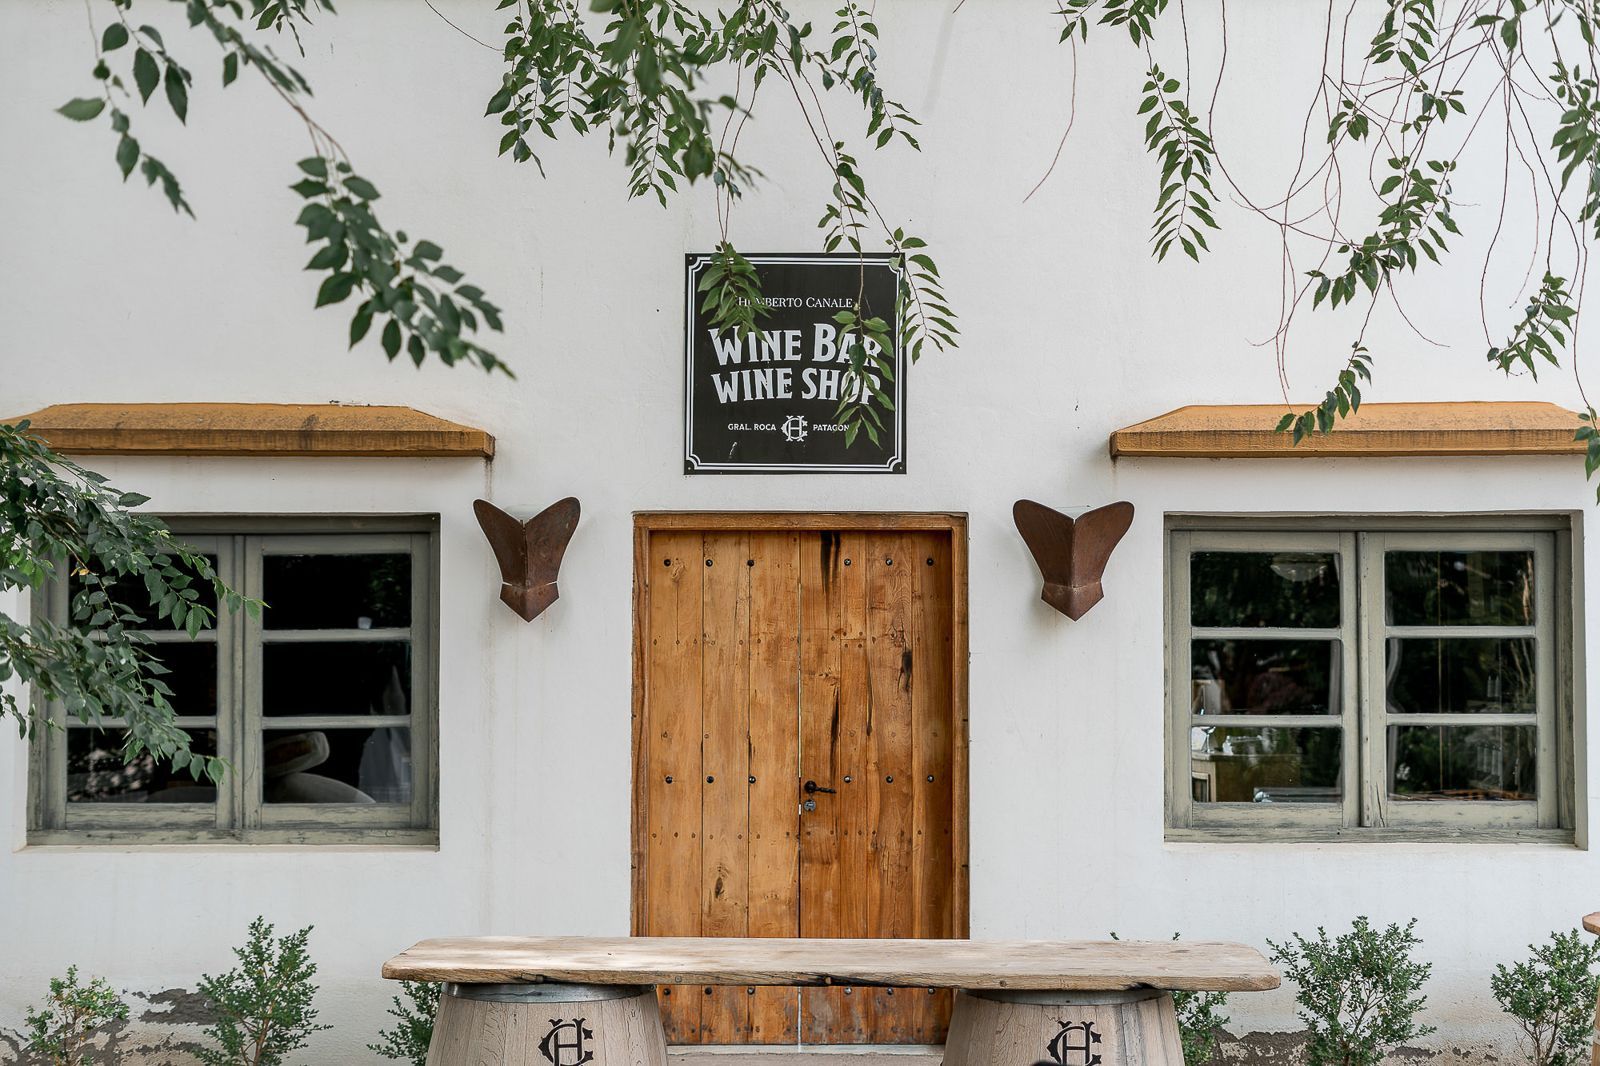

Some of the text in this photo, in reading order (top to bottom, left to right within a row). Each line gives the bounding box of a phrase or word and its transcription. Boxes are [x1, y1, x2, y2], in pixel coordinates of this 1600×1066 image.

[711, 367, 793, 404] WINE
[727, 423, 752, 431] GRAL.
[754, 423, 777, 431] ROCA
